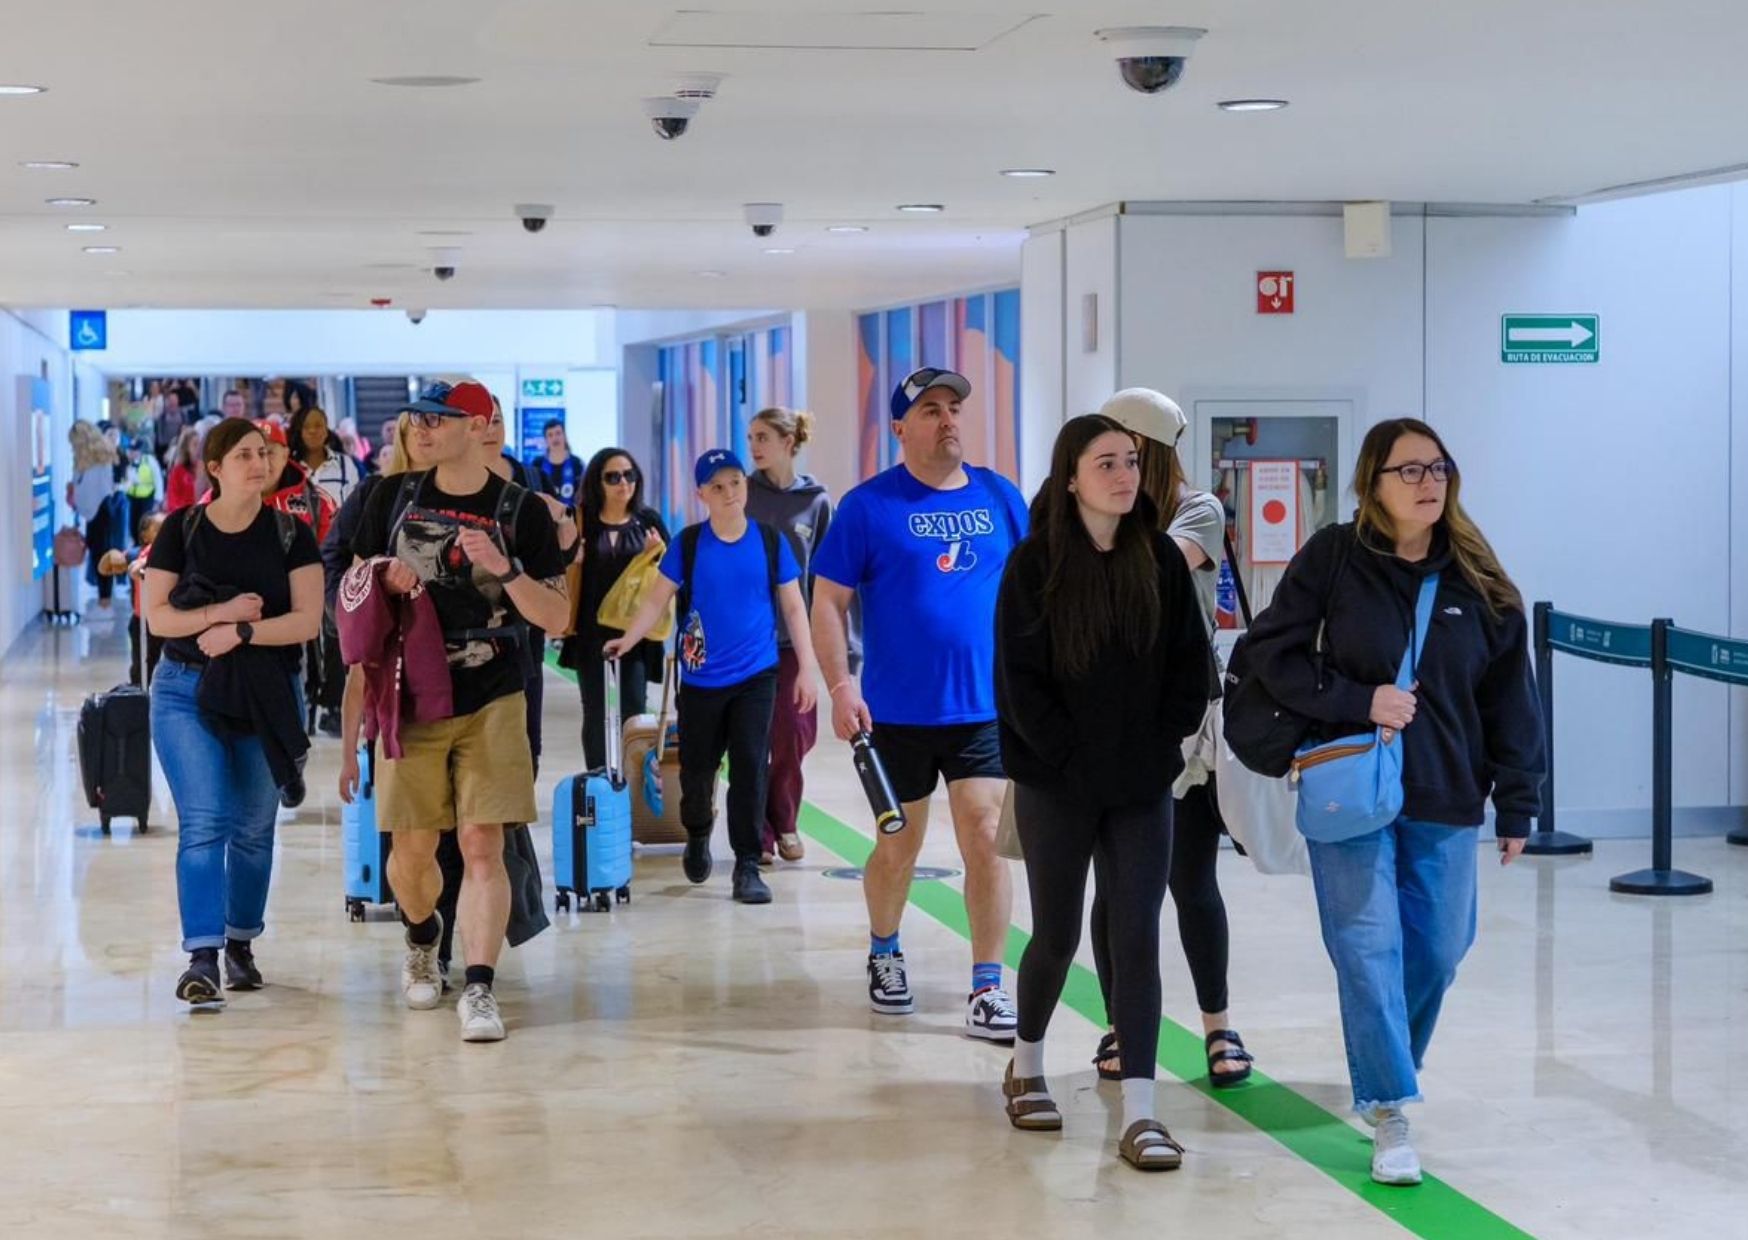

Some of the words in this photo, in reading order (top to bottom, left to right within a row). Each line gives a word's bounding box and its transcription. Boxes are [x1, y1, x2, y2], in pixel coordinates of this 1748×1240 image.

[1507, 353, 1529, 361] RUTA
[1530, 353, 1541, 361] DE
[908, 509, 994, 541] expos
